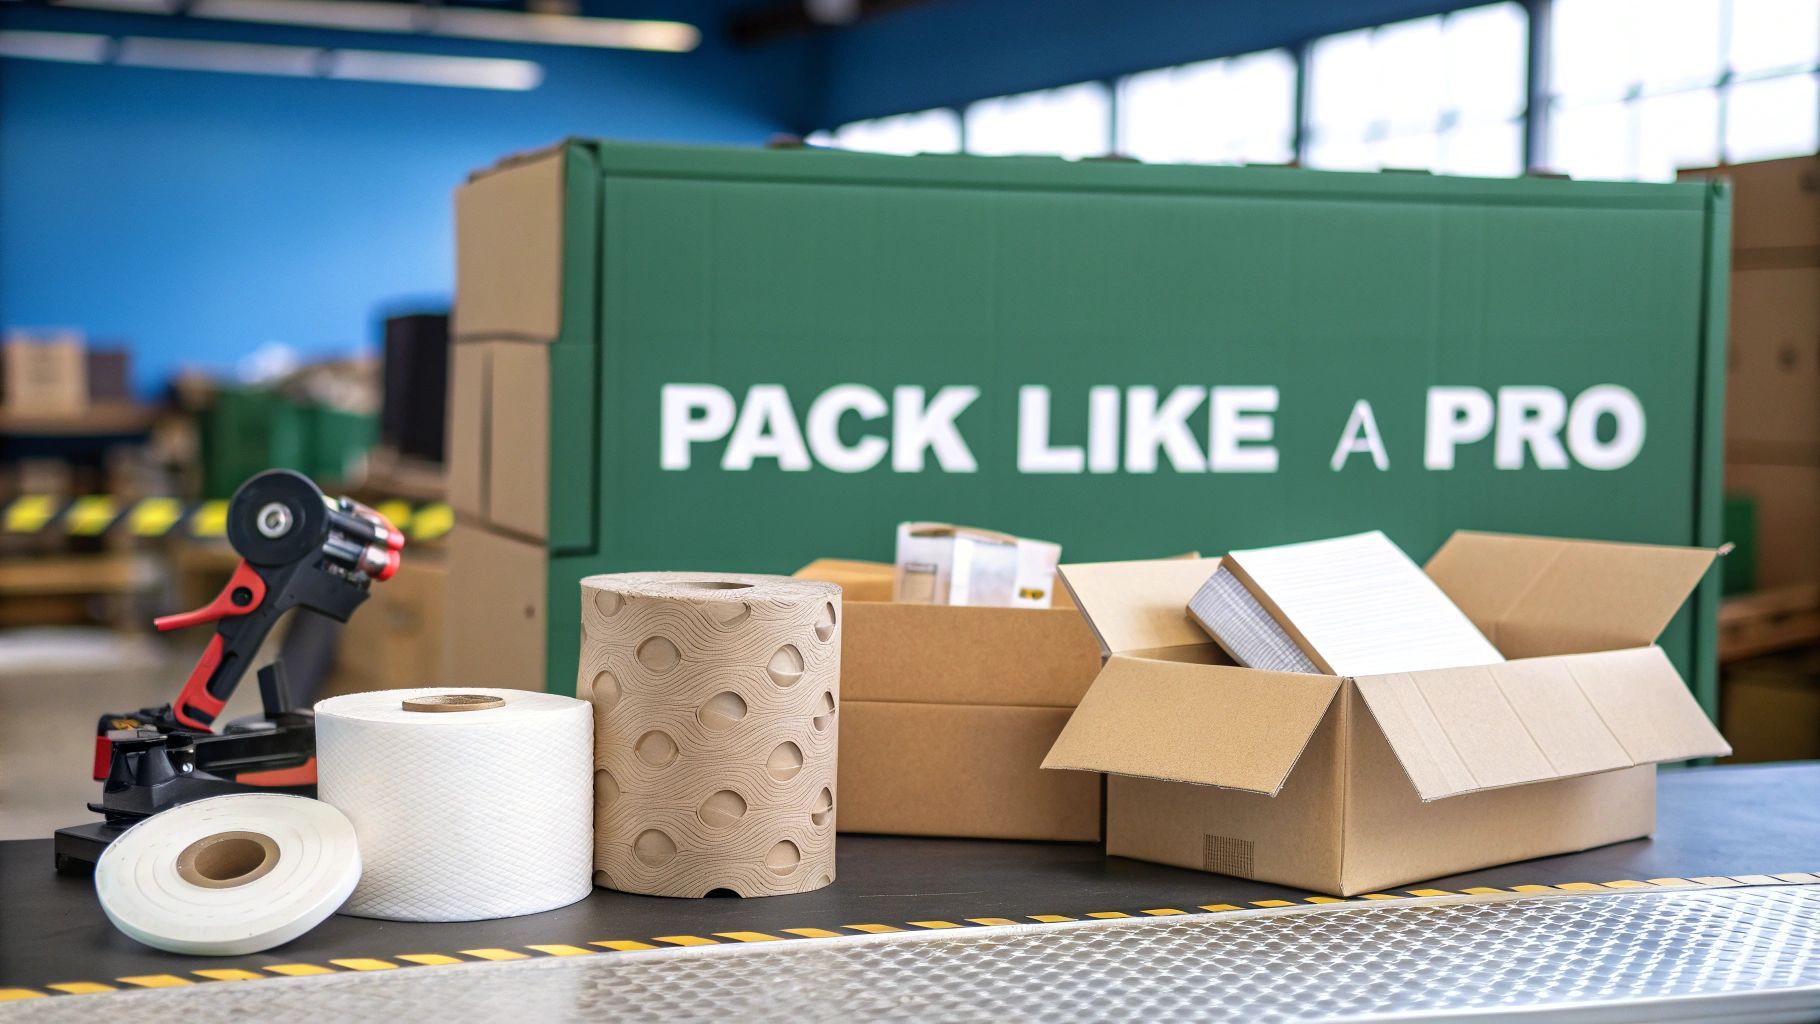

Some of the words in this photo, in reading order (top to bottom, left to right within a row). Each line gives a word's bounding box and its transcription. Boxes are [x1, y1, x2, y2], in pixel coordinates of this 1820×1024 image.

[660, 384, 979, 473] PACK
[1017, 386, 1280, 473] LIKE
[1330, 399, 1390, 471] A
[1424, 384, 1647, 471] PRO
